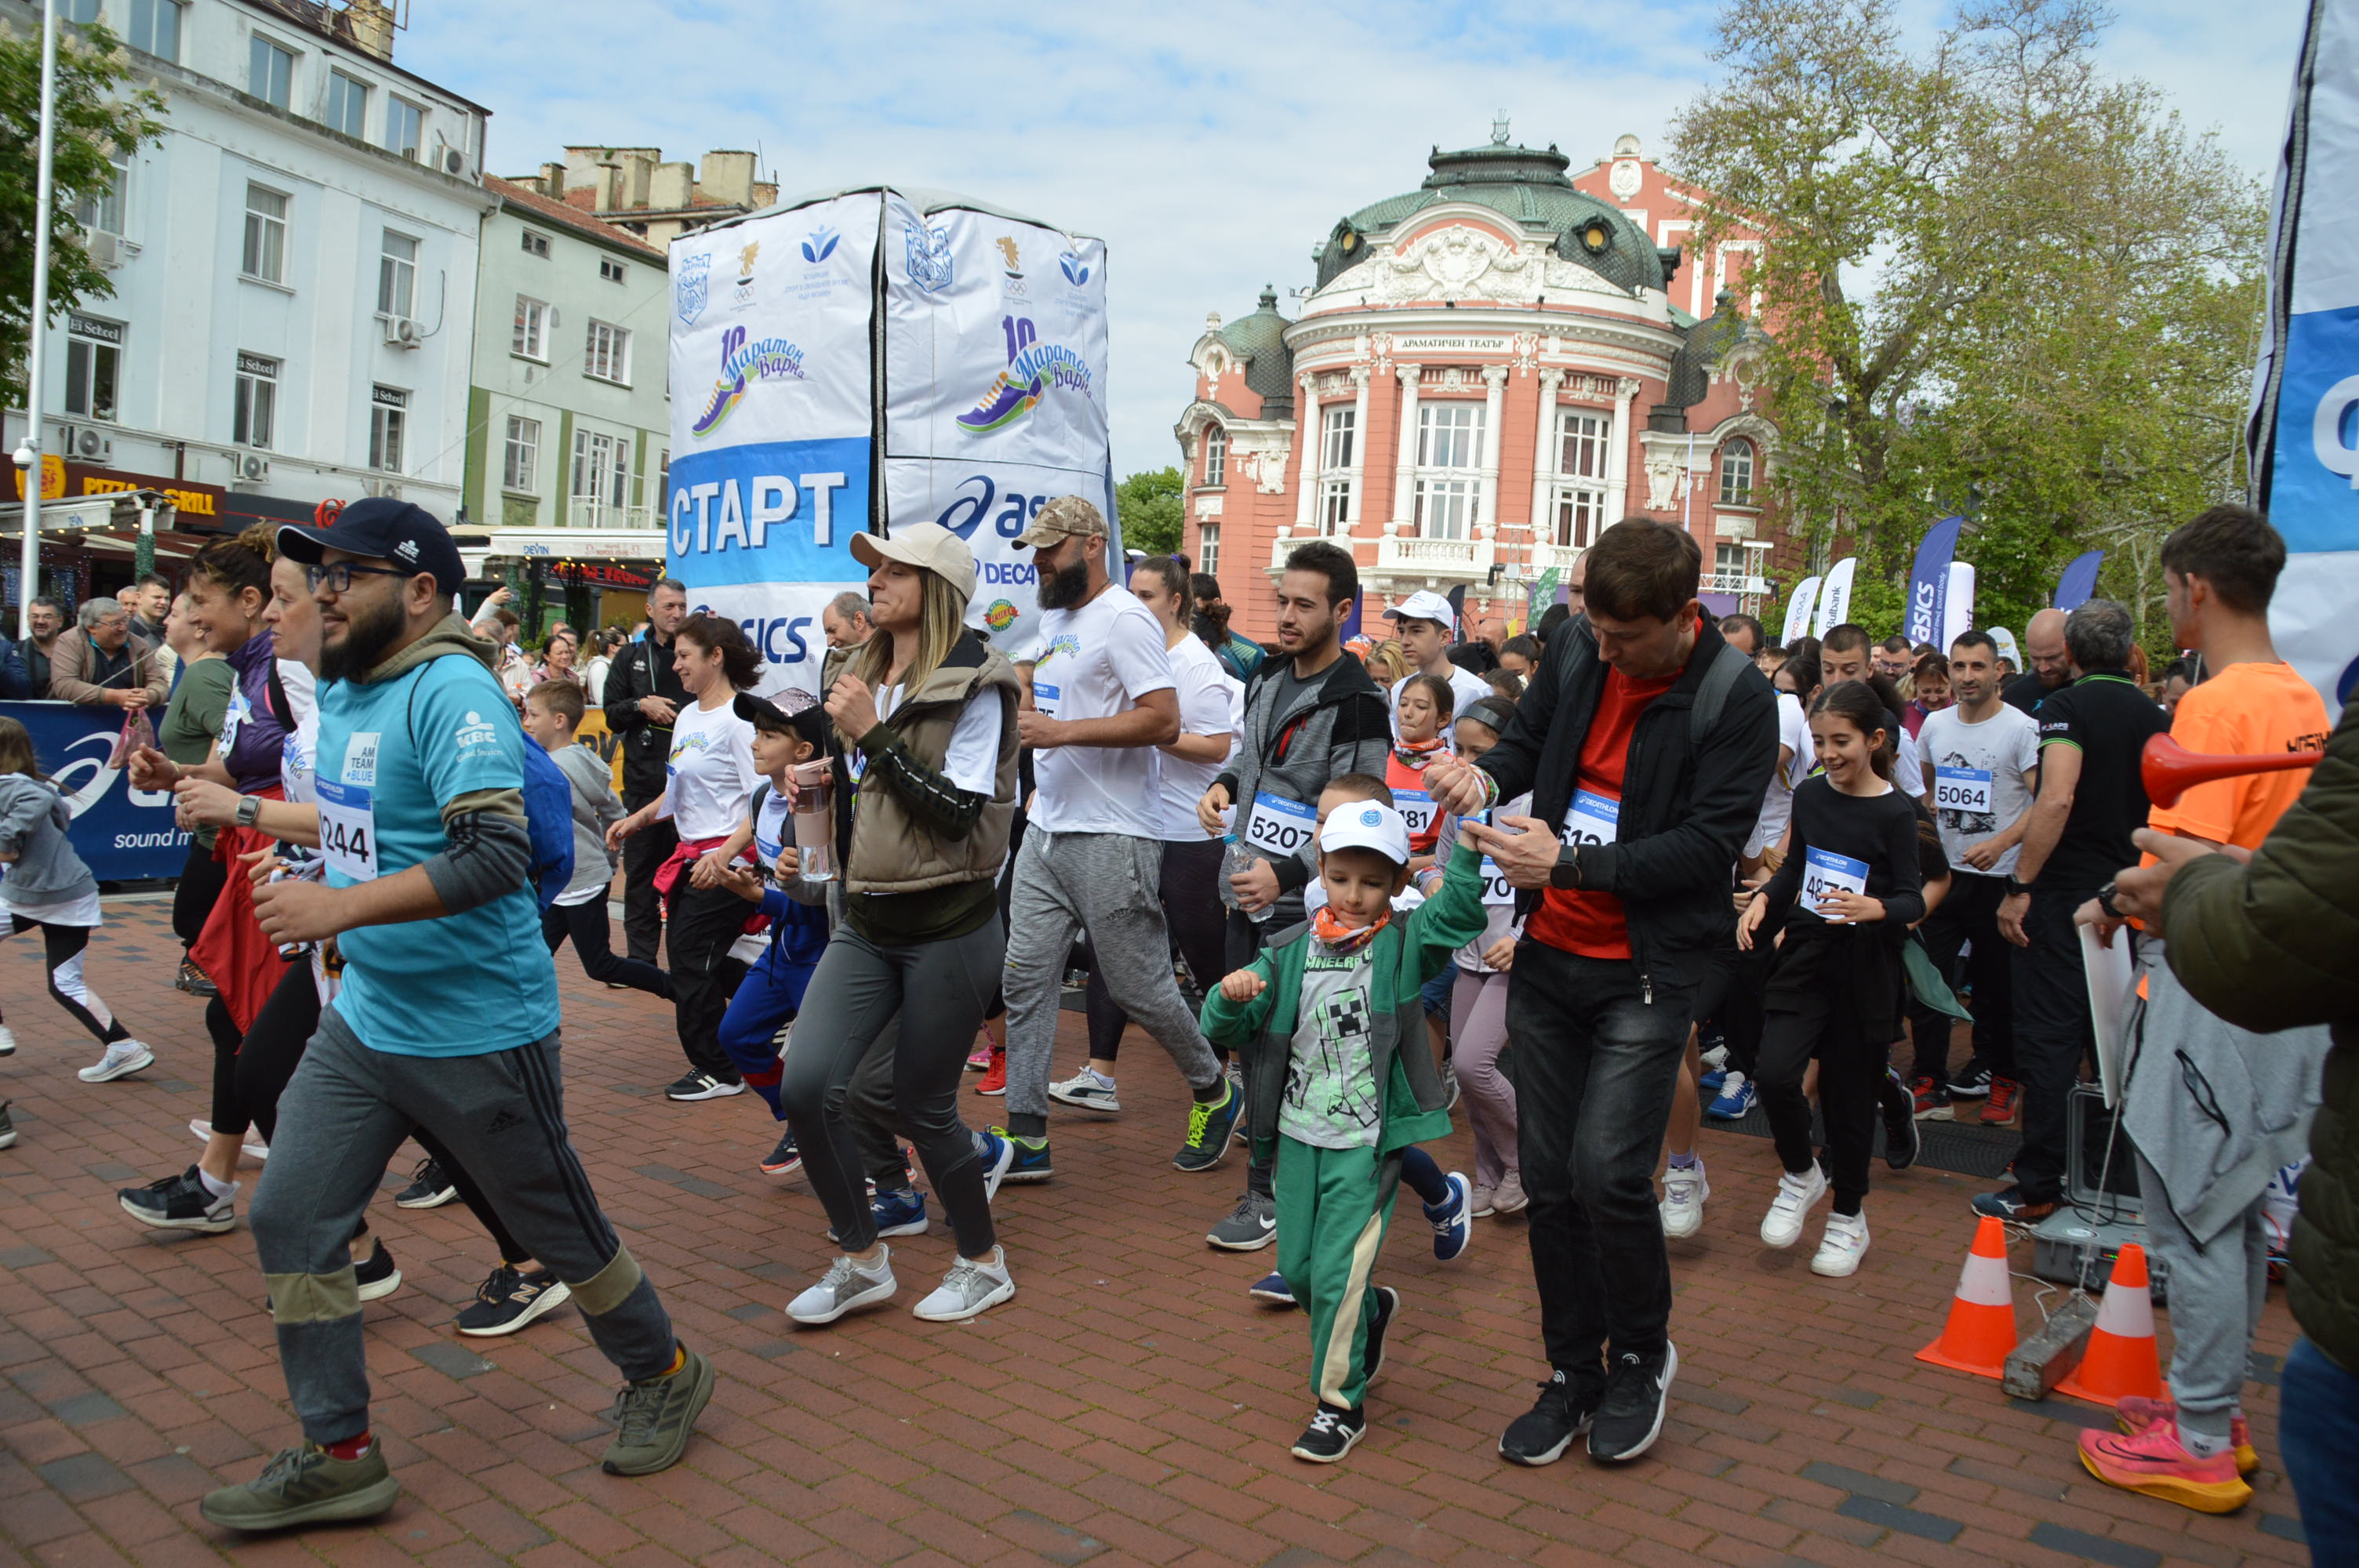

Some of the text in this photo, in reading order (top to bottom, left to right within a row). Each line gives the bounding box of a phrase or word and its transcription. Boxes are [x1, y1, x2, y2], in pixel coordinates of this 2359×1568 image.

[84, 321, 119, 340] School
[1402, 339, 1504, 348] ДРАМАТИЧЕН ТЕАТЪР
[725, 338, 805, 386] Маратон
[756, 355, 805, 379] Варна
[1015, 345, 1092, 387] Маратон
[163, 488, 216, 516] GRILL
[672, 472, 849, 558] СТАРТ
[523, 543, 550, 555] DEVIN
[985, 563, 1035, 585] DECA
[1826, 586, 1841, 629] Bulbank
[456, 731, 496, 749] KBC
[361, 746, 376, 758] AM
[351, 757, 374, 770] TEAM
[1278, 799, 1306, 811] DECATHLON
[1586, 798, 1619, 815] DECATHLON
[1938, 786, 1986, 807] 5064
[114, 828, 175, 848] sound
[1252, 815, 1314, 849] 5207
